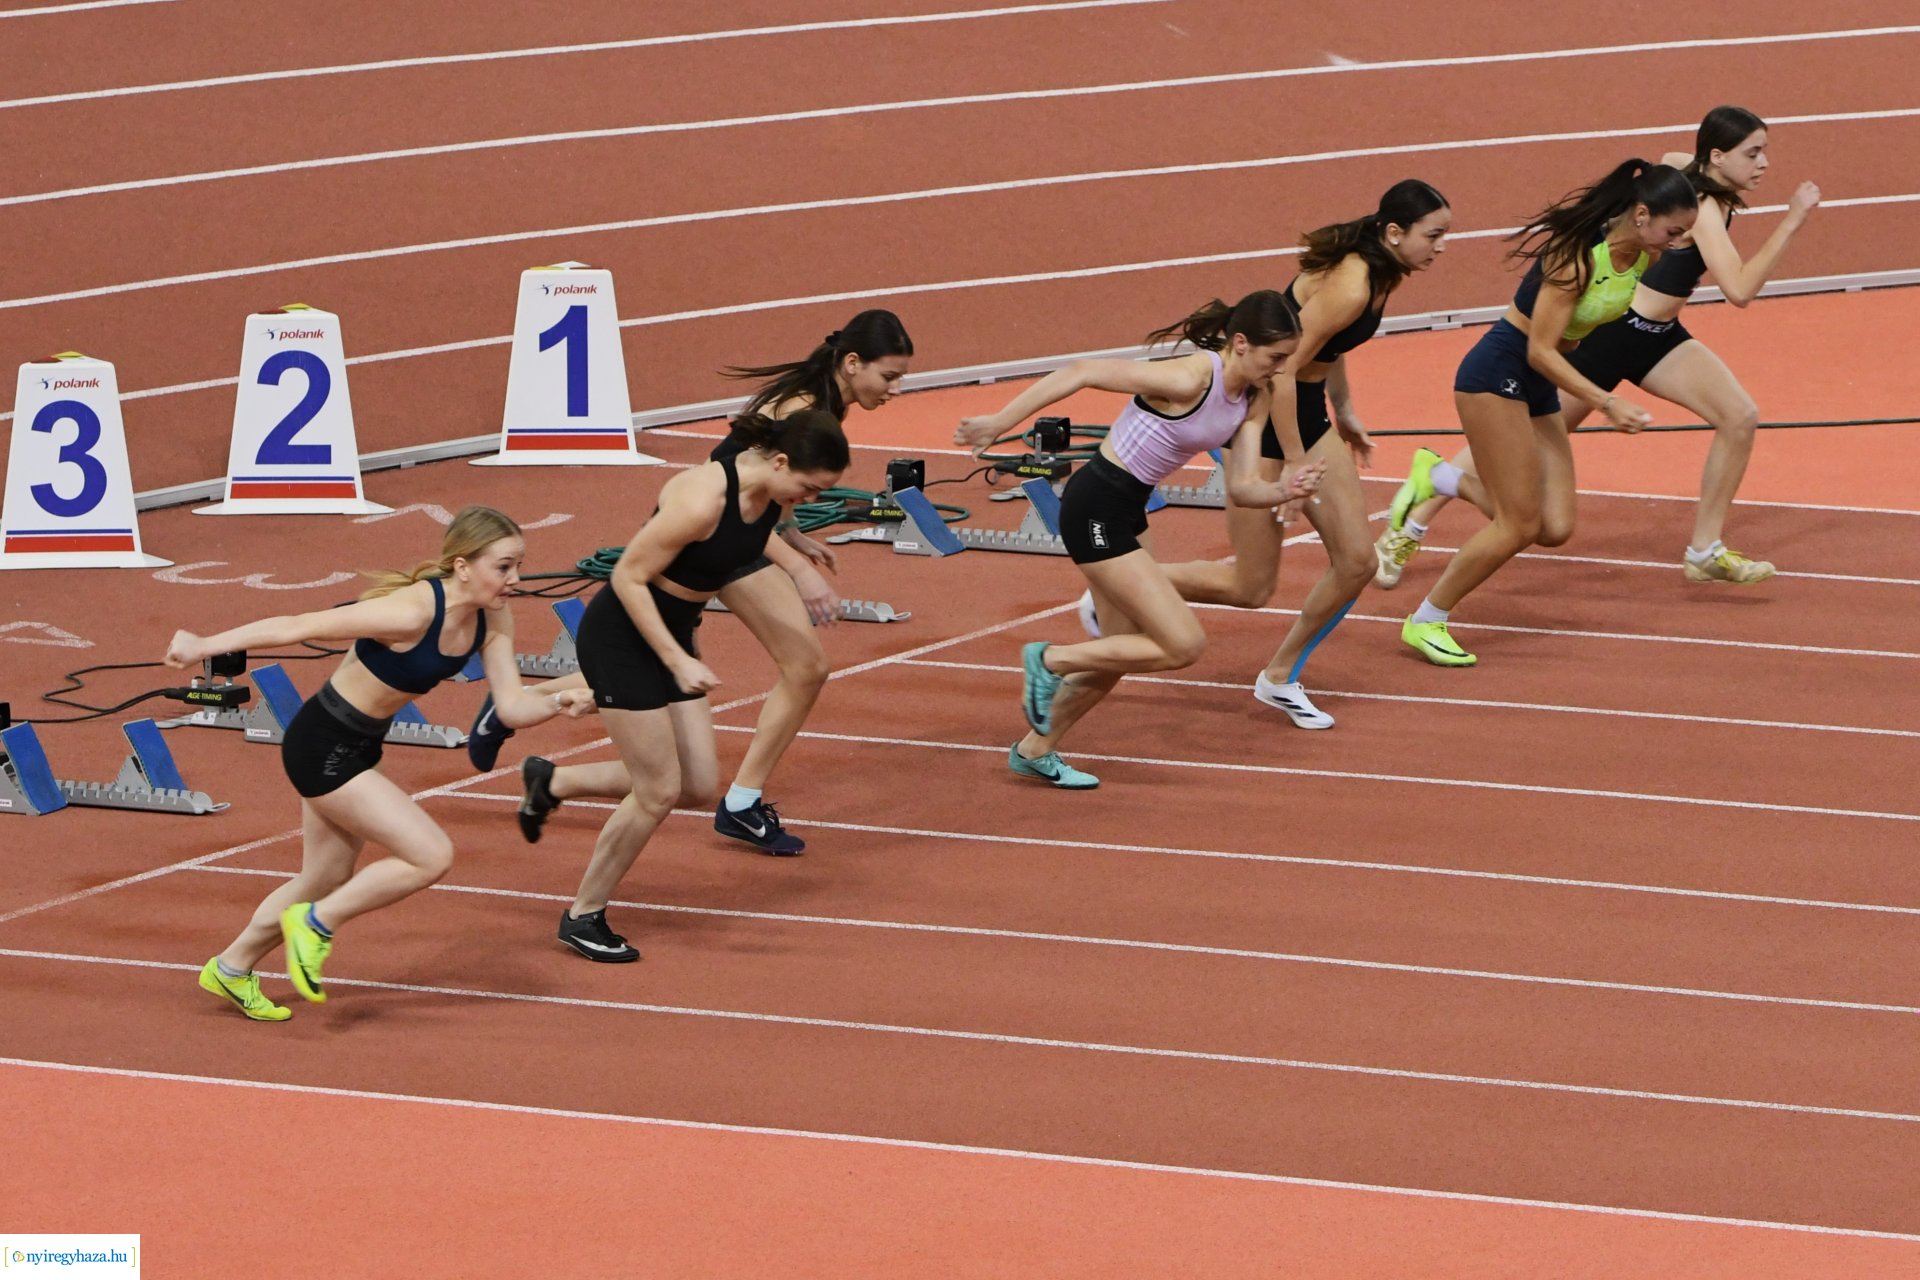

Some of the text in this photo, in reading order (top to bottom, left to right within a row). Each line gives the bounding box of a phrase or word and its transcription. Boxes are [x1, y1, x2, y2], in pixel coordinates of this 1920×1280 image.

[554, 284, 597, 296] polanik
[279, 328, 324, 341] polanik
[1627, 316, 1662, 333] NIKE
[539, 305, 589, 417] 1
[53, 377, 100, 390] polanik
[255, 350, 331, 464] 2
[30, 400, 107, 517] 3
[1092, 522, 1106, 546] NIKE
